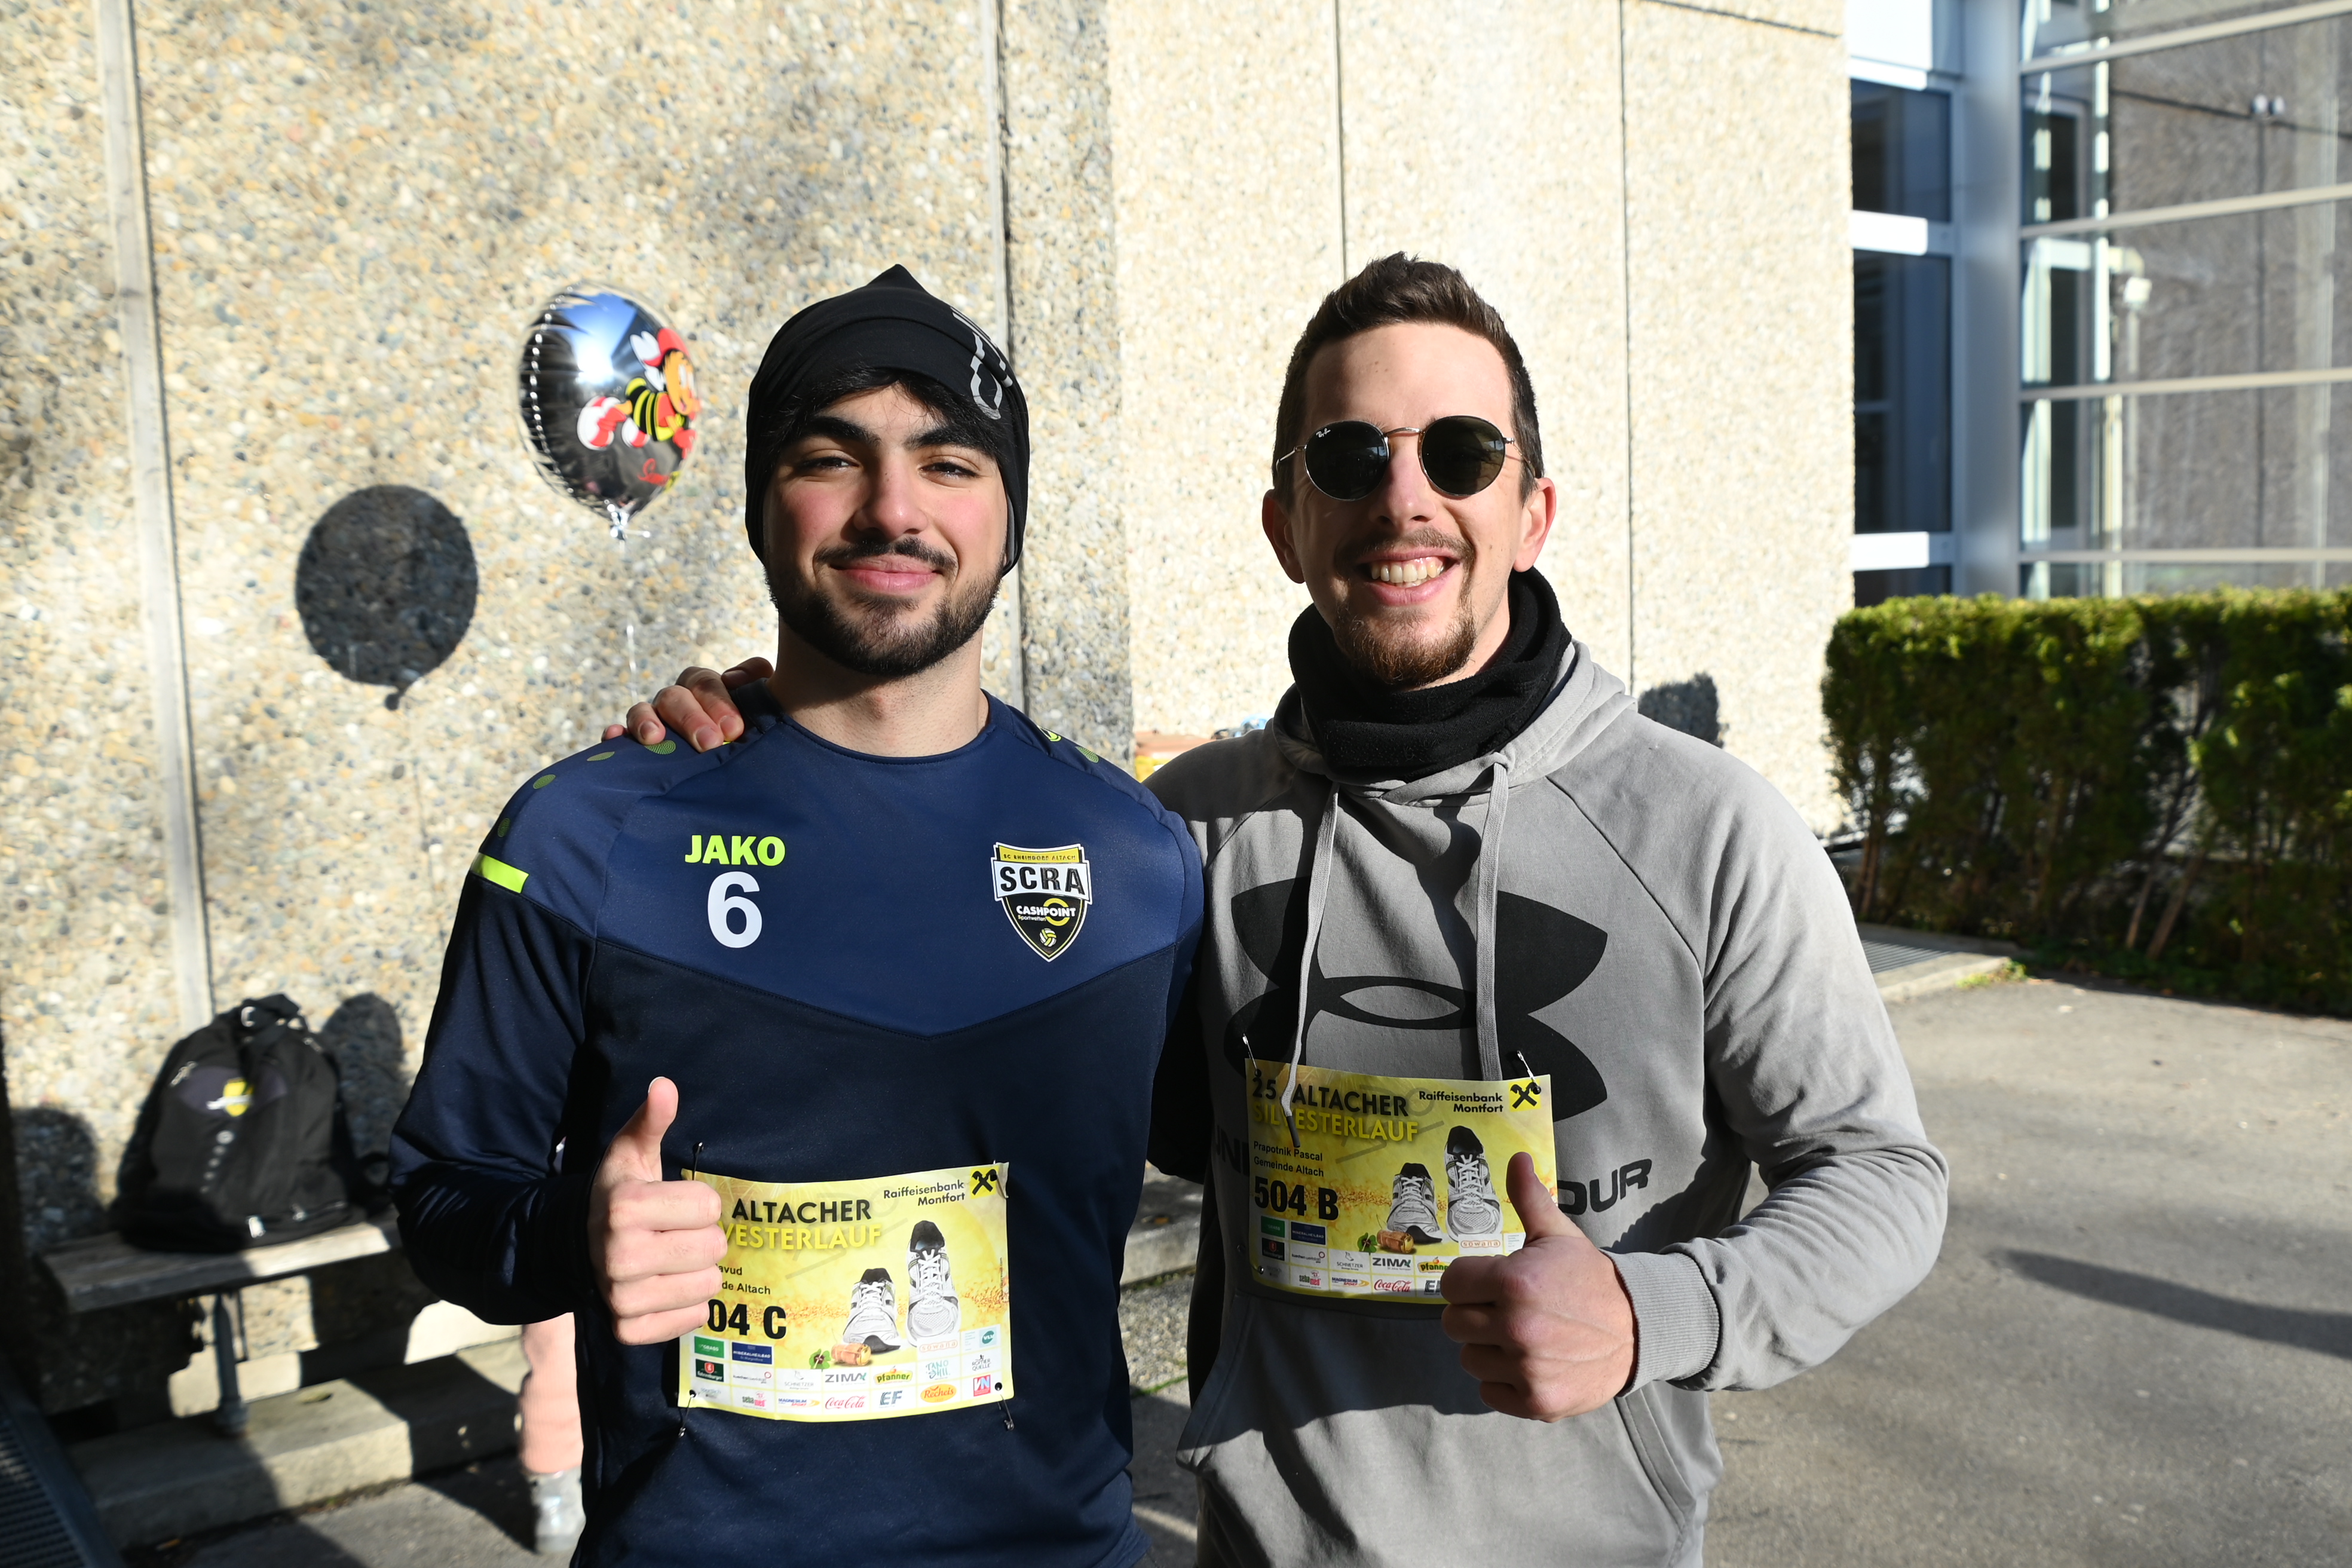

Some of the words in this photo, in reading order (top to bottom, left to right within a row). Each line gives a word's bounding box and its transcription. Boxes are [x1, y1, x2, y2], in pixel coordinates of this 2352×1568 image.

[685, 835, 785, 866] JAKO
[1000, 866, 1086, 896] SCRA
[708, 871, 763, 949] 6
[1016, 905, 1076, 917] CASHPOINT
[1252, 1077, 1282, 1100] 25
[1292, 1083, 1409, 1117] ALTACHER
[1419, 1091, 1503, 1102] Raiffeisenbank
[1453, 1103, 1503, 1113] Montfort
[1254, 1101, 1419, 1142] SILESTERLAUF
[1254, 1140, 1292, 1156] Prapotnik
[1294, 1149, 1323, 1162] Pascal
[1254, 1156, 1294, 1172] Gemeinde
[1296, 1165, 1324, 1177] Altach
[883, 1179, 964, 1199] Raiffeisenbank
[917, 1192, 966, 1206] Montfort
[1255, 1175, 1307, 1217] 504
[1318, 1187, 1339, 1221] B
[731, 1198, 872, 1224] ALTACHER
[715, 1263, 743, 1276] avud
[1372, 1257, 1411, 1268] ZIMA
[736, 1282, 771, 1296] Altach
[707, 1298, 751, 1336] 04
[764, 1305, 787, 1340] C
[921, 1341, 956, 1351] sowana
[825, 1372, 867, 1383] ZIMA
[877, 1373, 911, 1383] pfanner
[924, 1387, 954, 1399] Recheis
